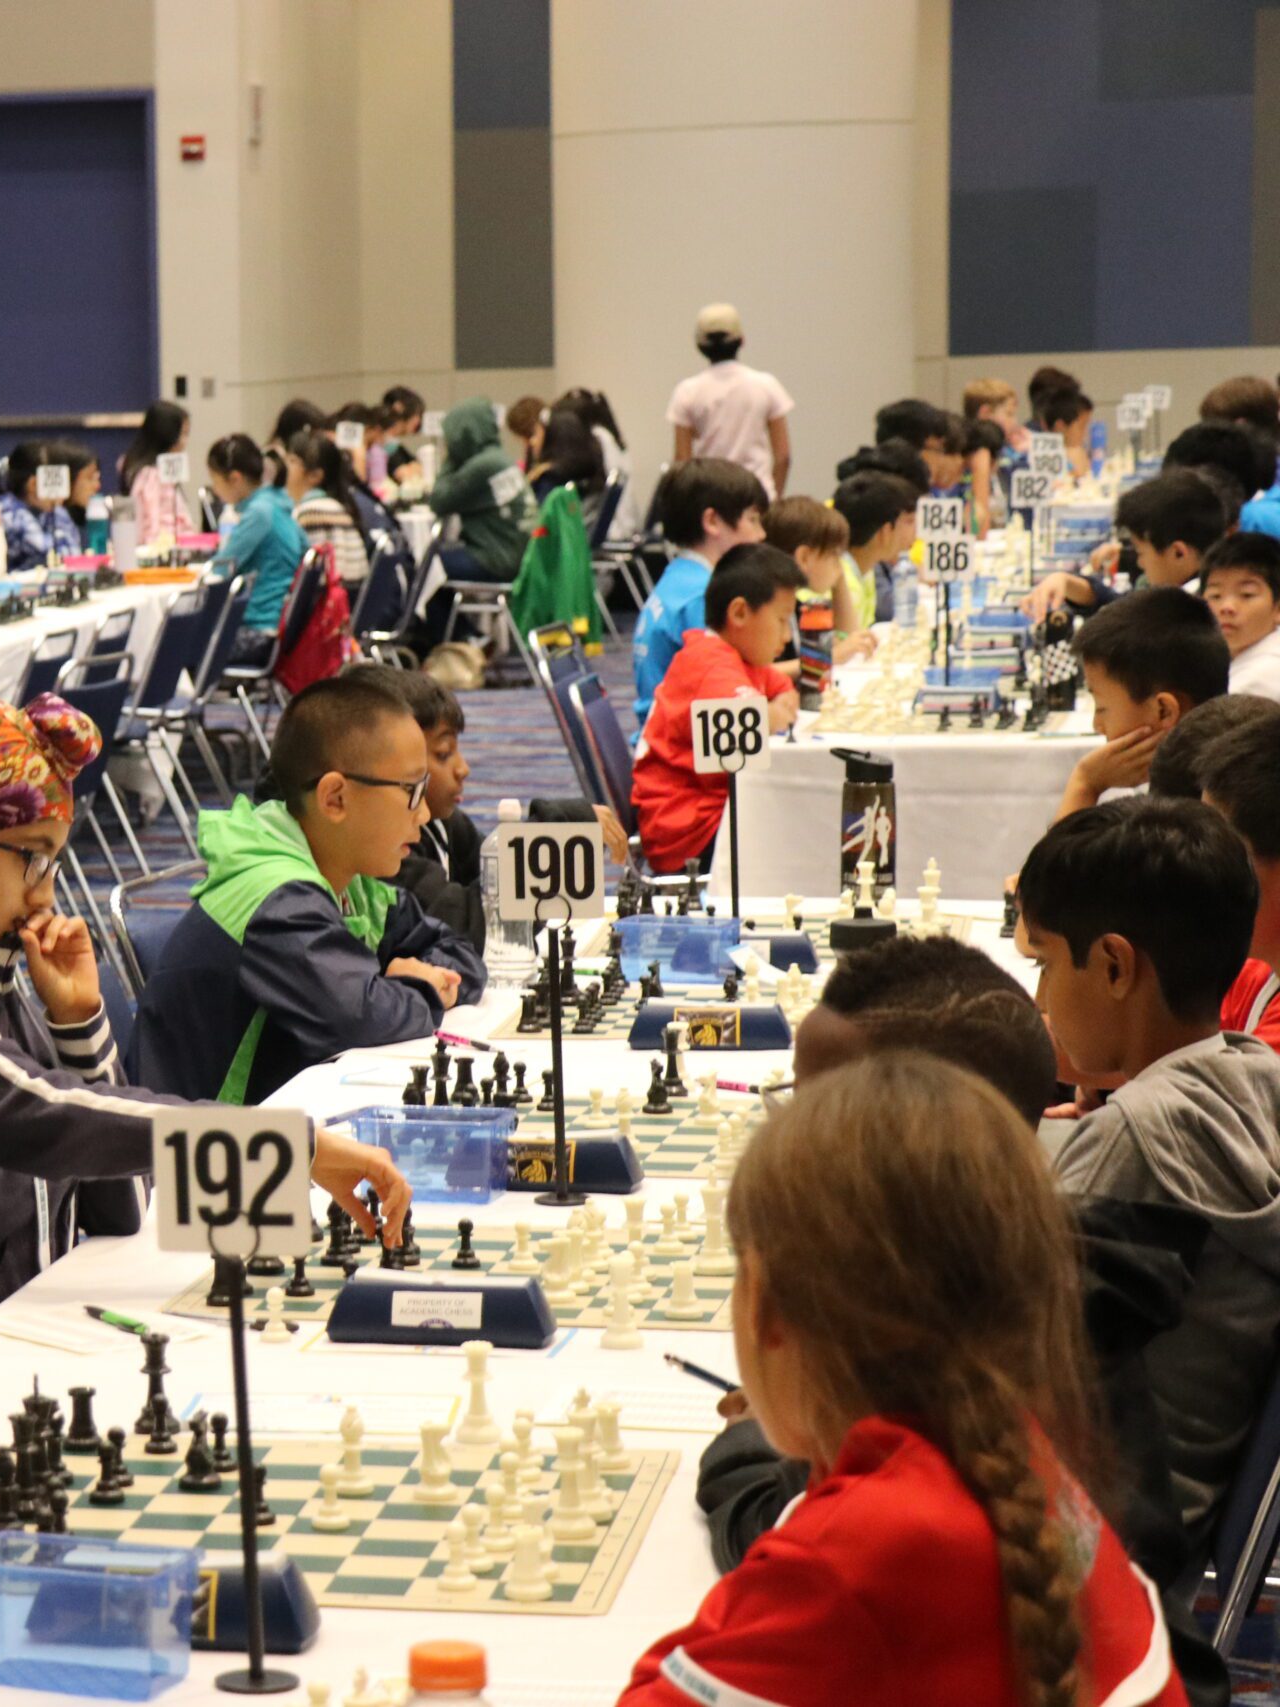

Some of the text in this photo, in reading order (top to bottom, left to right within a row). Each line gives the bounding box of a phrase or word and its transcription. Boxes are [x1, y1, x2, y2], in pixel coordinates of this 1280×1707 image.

[1017, 476, 1048, 500] 182
[922, 504, 958, 530] 184
[928, 541, 969, 571] 186
[696, 706, 763, 757] 188
[507, 835, 596, 901] 190
[164, 1129, 295, 1227] 192
[400, 1308, 474, 1316] ACADEMIC CHESS
[407, 1299, 465, 1307] PROPERTY OF
